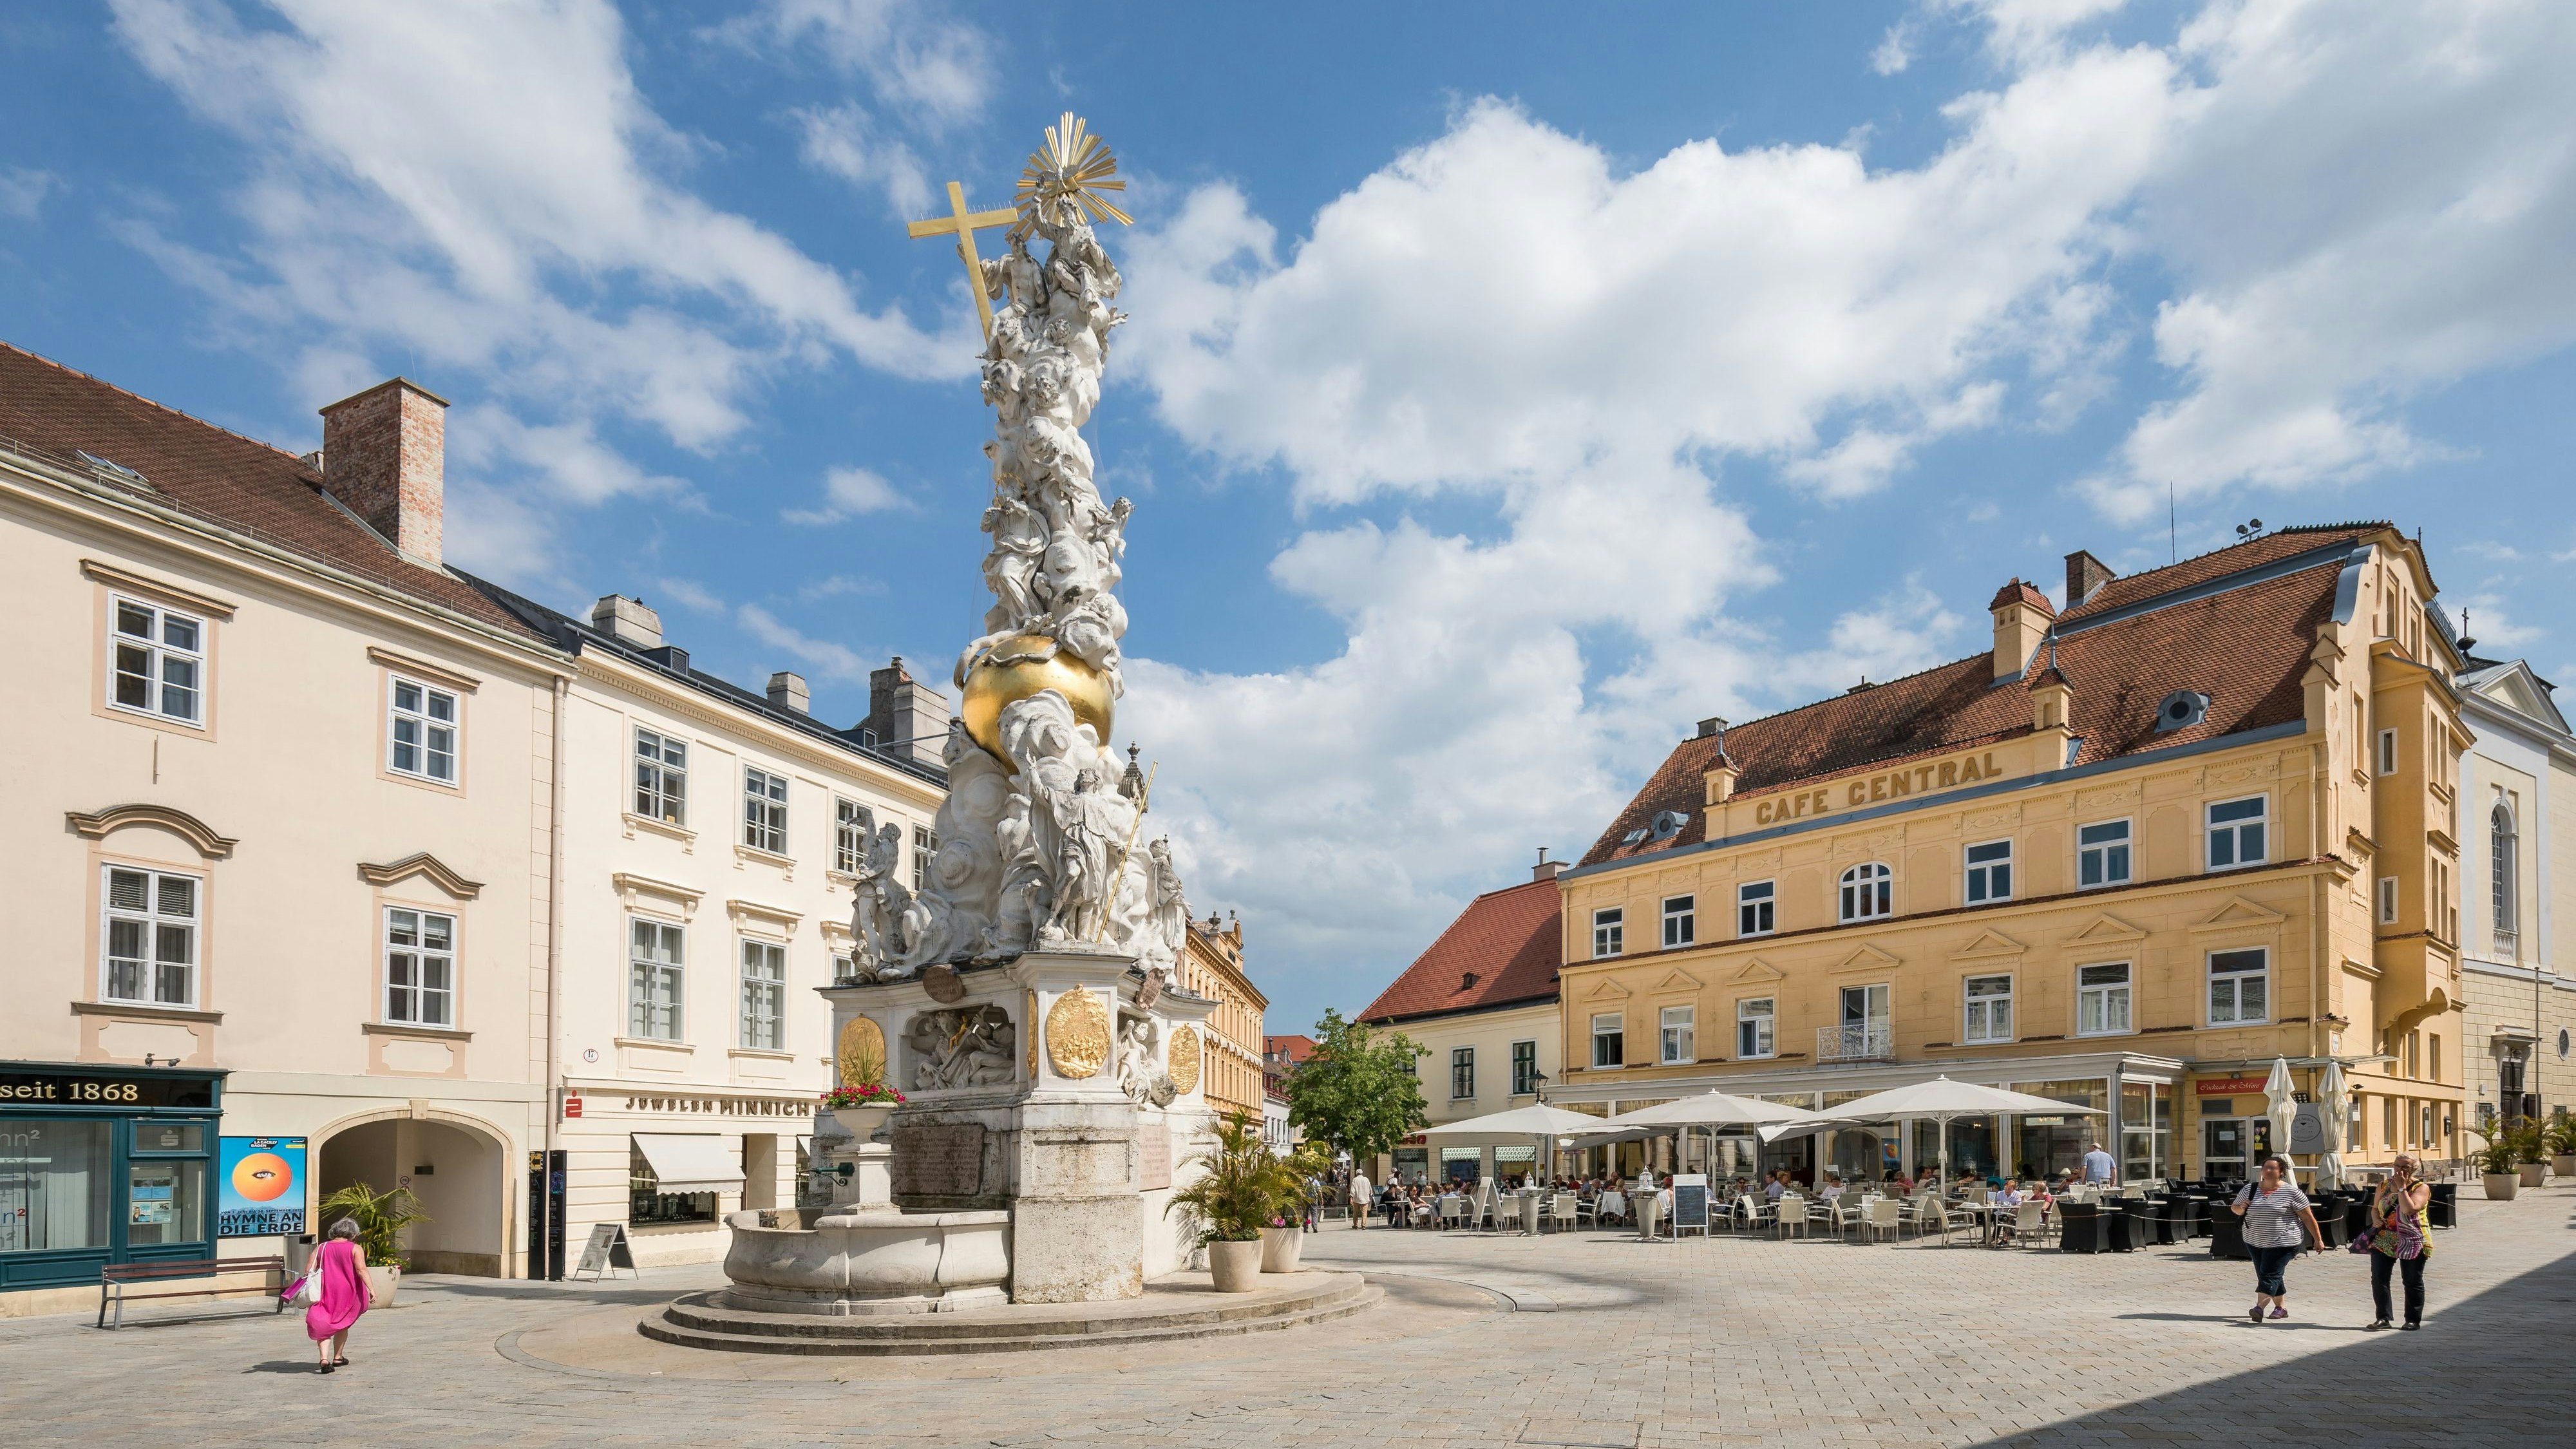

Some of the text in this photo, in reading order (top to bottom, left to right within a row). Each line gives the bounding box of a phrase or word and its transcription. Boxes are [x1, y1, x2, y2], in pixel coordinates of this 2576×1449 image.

[1756, 752, 2003, 825] CAFE CENTRAL
[0, 1081, 138, 1101] seit 1868
[625, 1097, 713, 1113] JUWELEN
[720, 1099, 810, 1116] MINNICH
[220, 1212, 302, 1224] HYMNE AN
[220, 1222, 302, 1235] DIE ERDE
